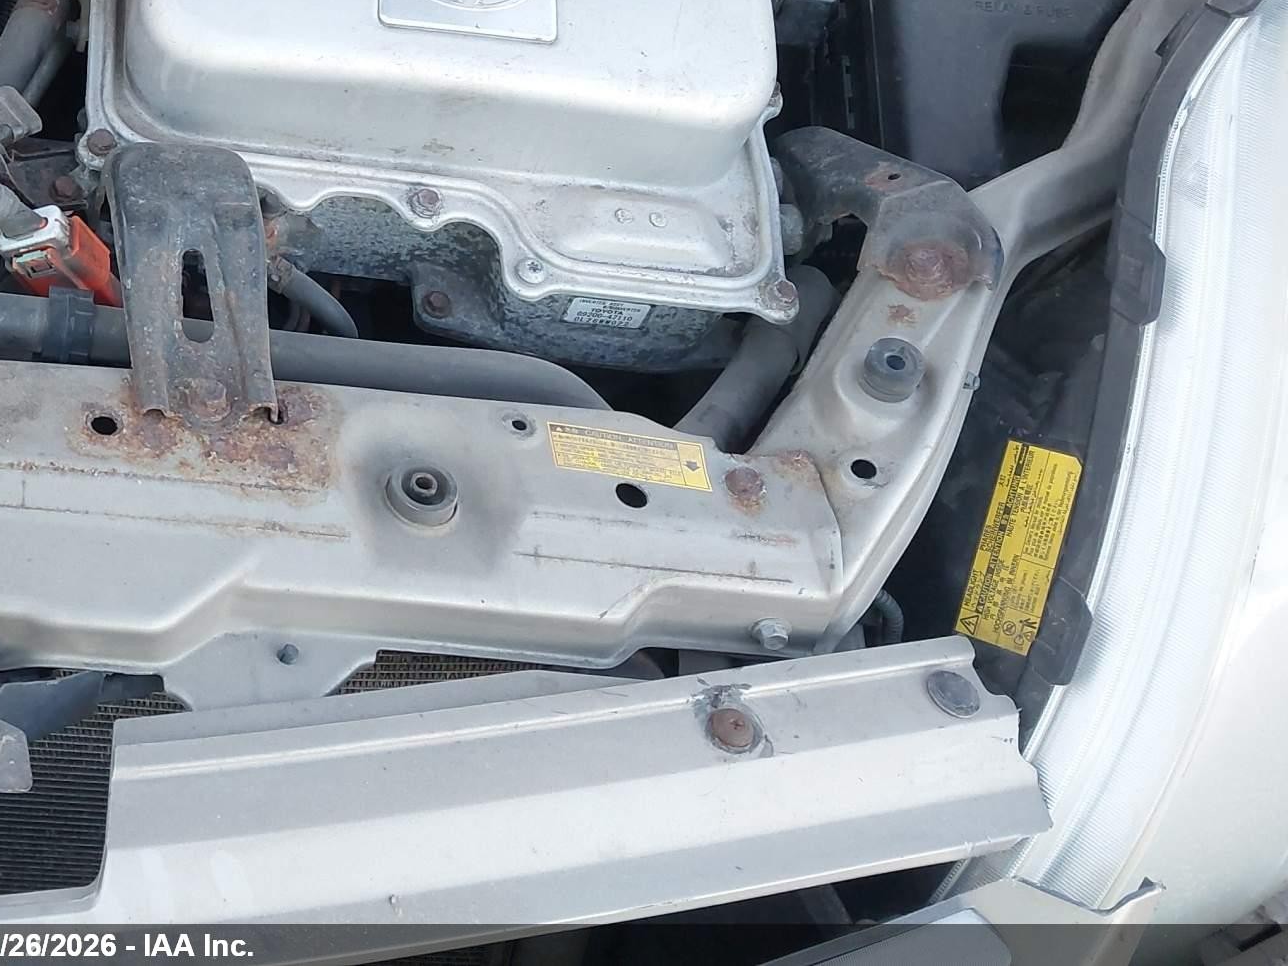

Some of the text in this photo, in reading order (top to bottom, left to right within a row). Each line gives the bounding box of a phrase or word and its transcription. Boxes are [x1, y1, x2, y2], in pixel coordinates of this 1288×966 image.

[591, 307, 624, 315] TOYOTA
[977, 572, 993, 604] CAUTION
[987, 529, 1005, 569] ATTENTION
